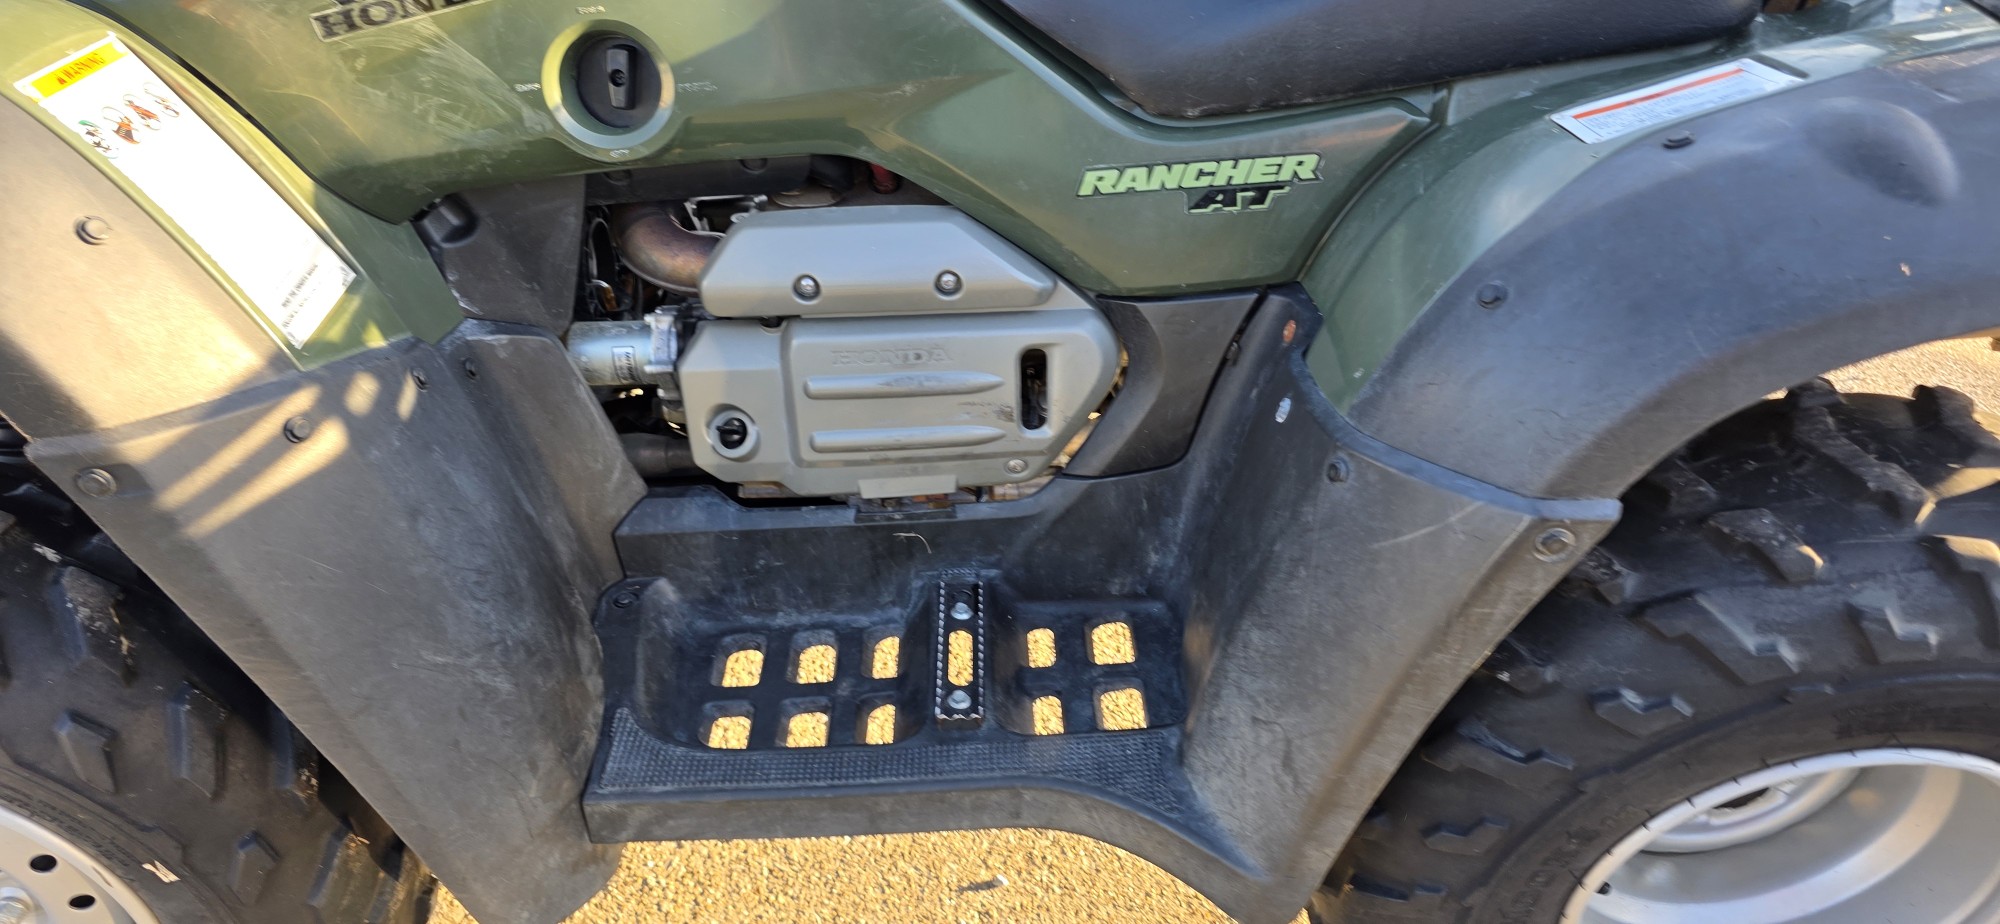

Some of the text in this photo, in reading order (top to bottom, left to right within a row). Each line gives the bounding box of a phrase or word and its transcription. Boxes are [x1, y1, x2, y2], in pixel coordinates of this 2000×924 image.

[1076, 153, 1321, 197] RANCHER
[1188, 185, 1291, 213] AT
[831, 346, 954, 367] HONDA
